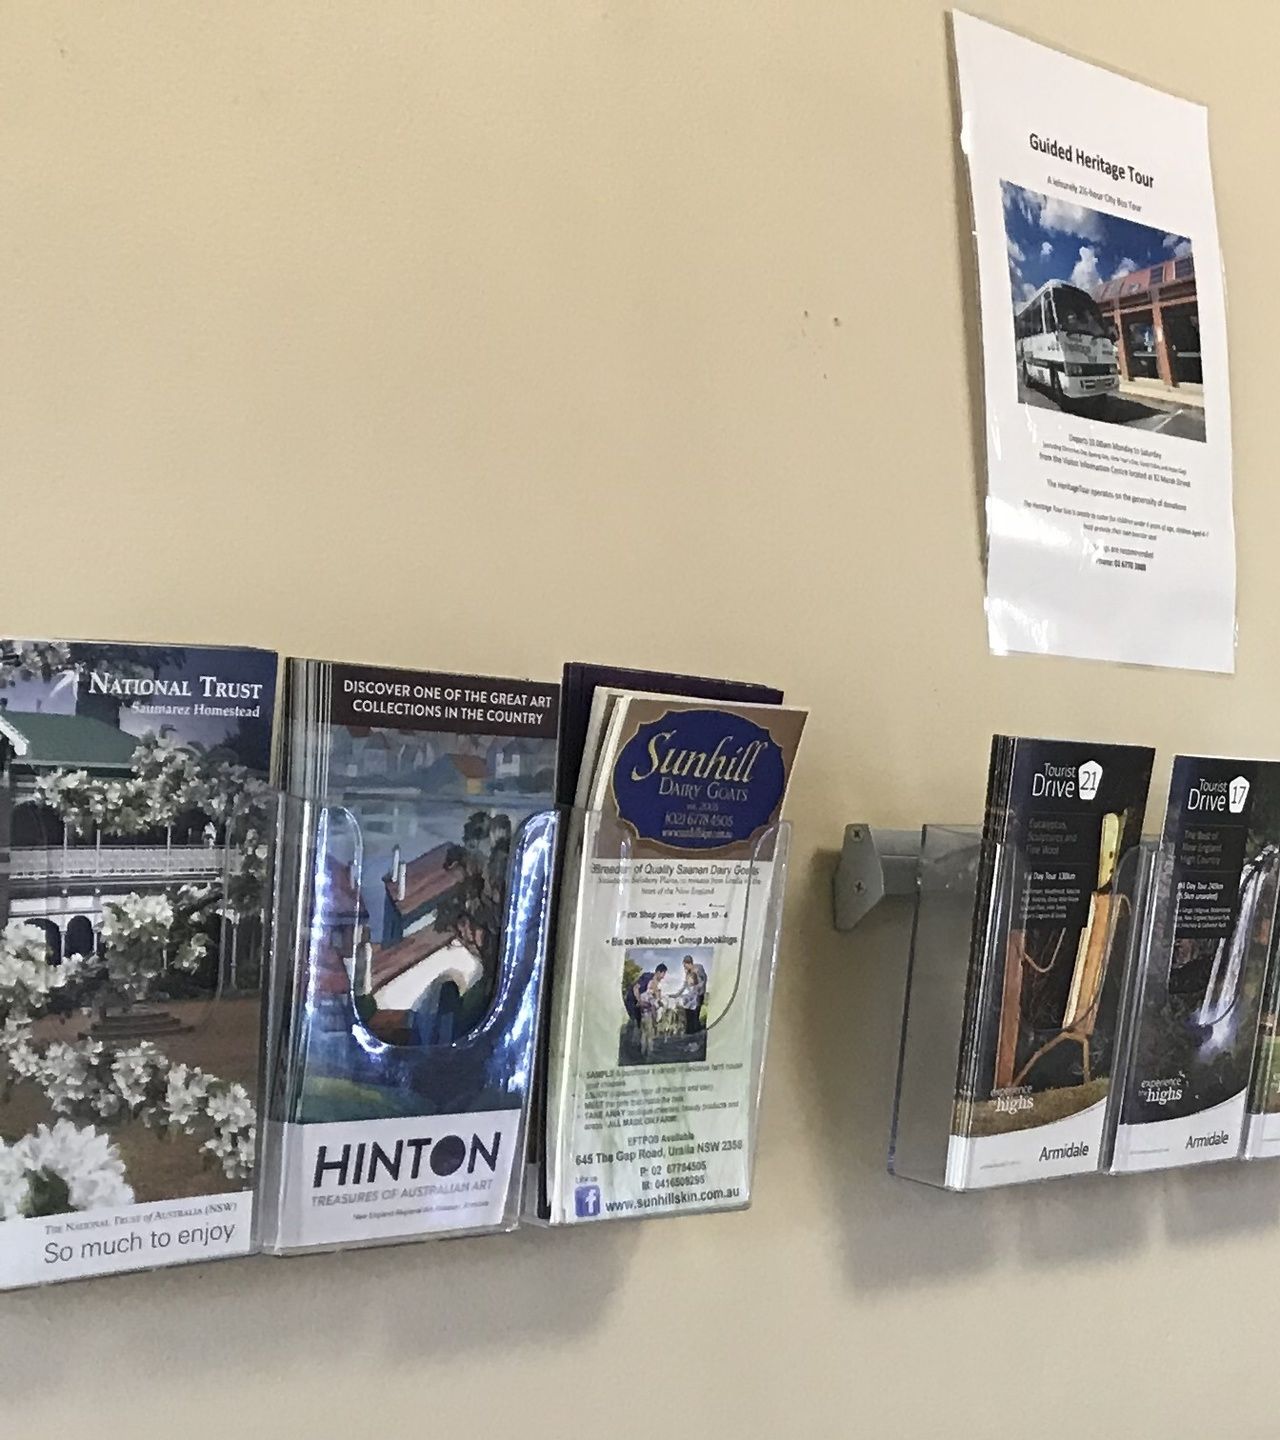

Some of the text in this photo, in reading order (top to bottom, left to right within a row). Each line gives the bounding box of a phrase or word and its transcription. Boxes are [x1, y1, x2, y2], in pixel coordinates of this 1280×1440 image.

[1029, 133, 1154, 188] Guided Heritage Tour
[1128, 201, 1142, 212] Tour
[88, 671, 263, 700] NATIONAL TRUST
[344, 679, 552, 709] DISCOVER ONE OF THE GREAT ART
[132, 700, 260, 719] Saumarez Homestead
[352, 699, 544, 725] COLLECTIONS IN THE COUNTRY
[631, 729, 769, 784] Sunhill
[1045, 763, 1076, 777] Tourist
[659, 777, 748, 801] DAIRY GOATS
[1032, 771, 1097, 797] Drive 21
[1200, 778, 1227, 793] Tourist
[1188, 786, 1247, 811] Drive 17
[634, 864, 733, 877] of Quality Dairy
[1034, 873, 1044, 881] Day
[636, 935, 737, 946] Welcome Group bookings
[1141, 1077, 1181, 1088] experience
[995, 1096, 1034, 1114] highs
[1146, 1087, 1182, 1106] highs
[1186, 1130, 1229, 1149] Armidale
[313, 1131, 502, 1188] HINTON
[576, 1142, 719, 1165] 645 The Gap Road, NSW
[1039, 1142, 1089, 1162] Armidale
[652, 1165, 662, 1175] 02
[311, 1179, 494, 1207] TREASURES OF AUSTRALIAN ART
[605, 1187, 740, 1212] www.sunhillskin.com.au
[66, 1201, 238, 1232] NATIONAL TRUST of AUSTRALIA (NSW)
[44, 1223, 236, 1264] So much to enjoy
